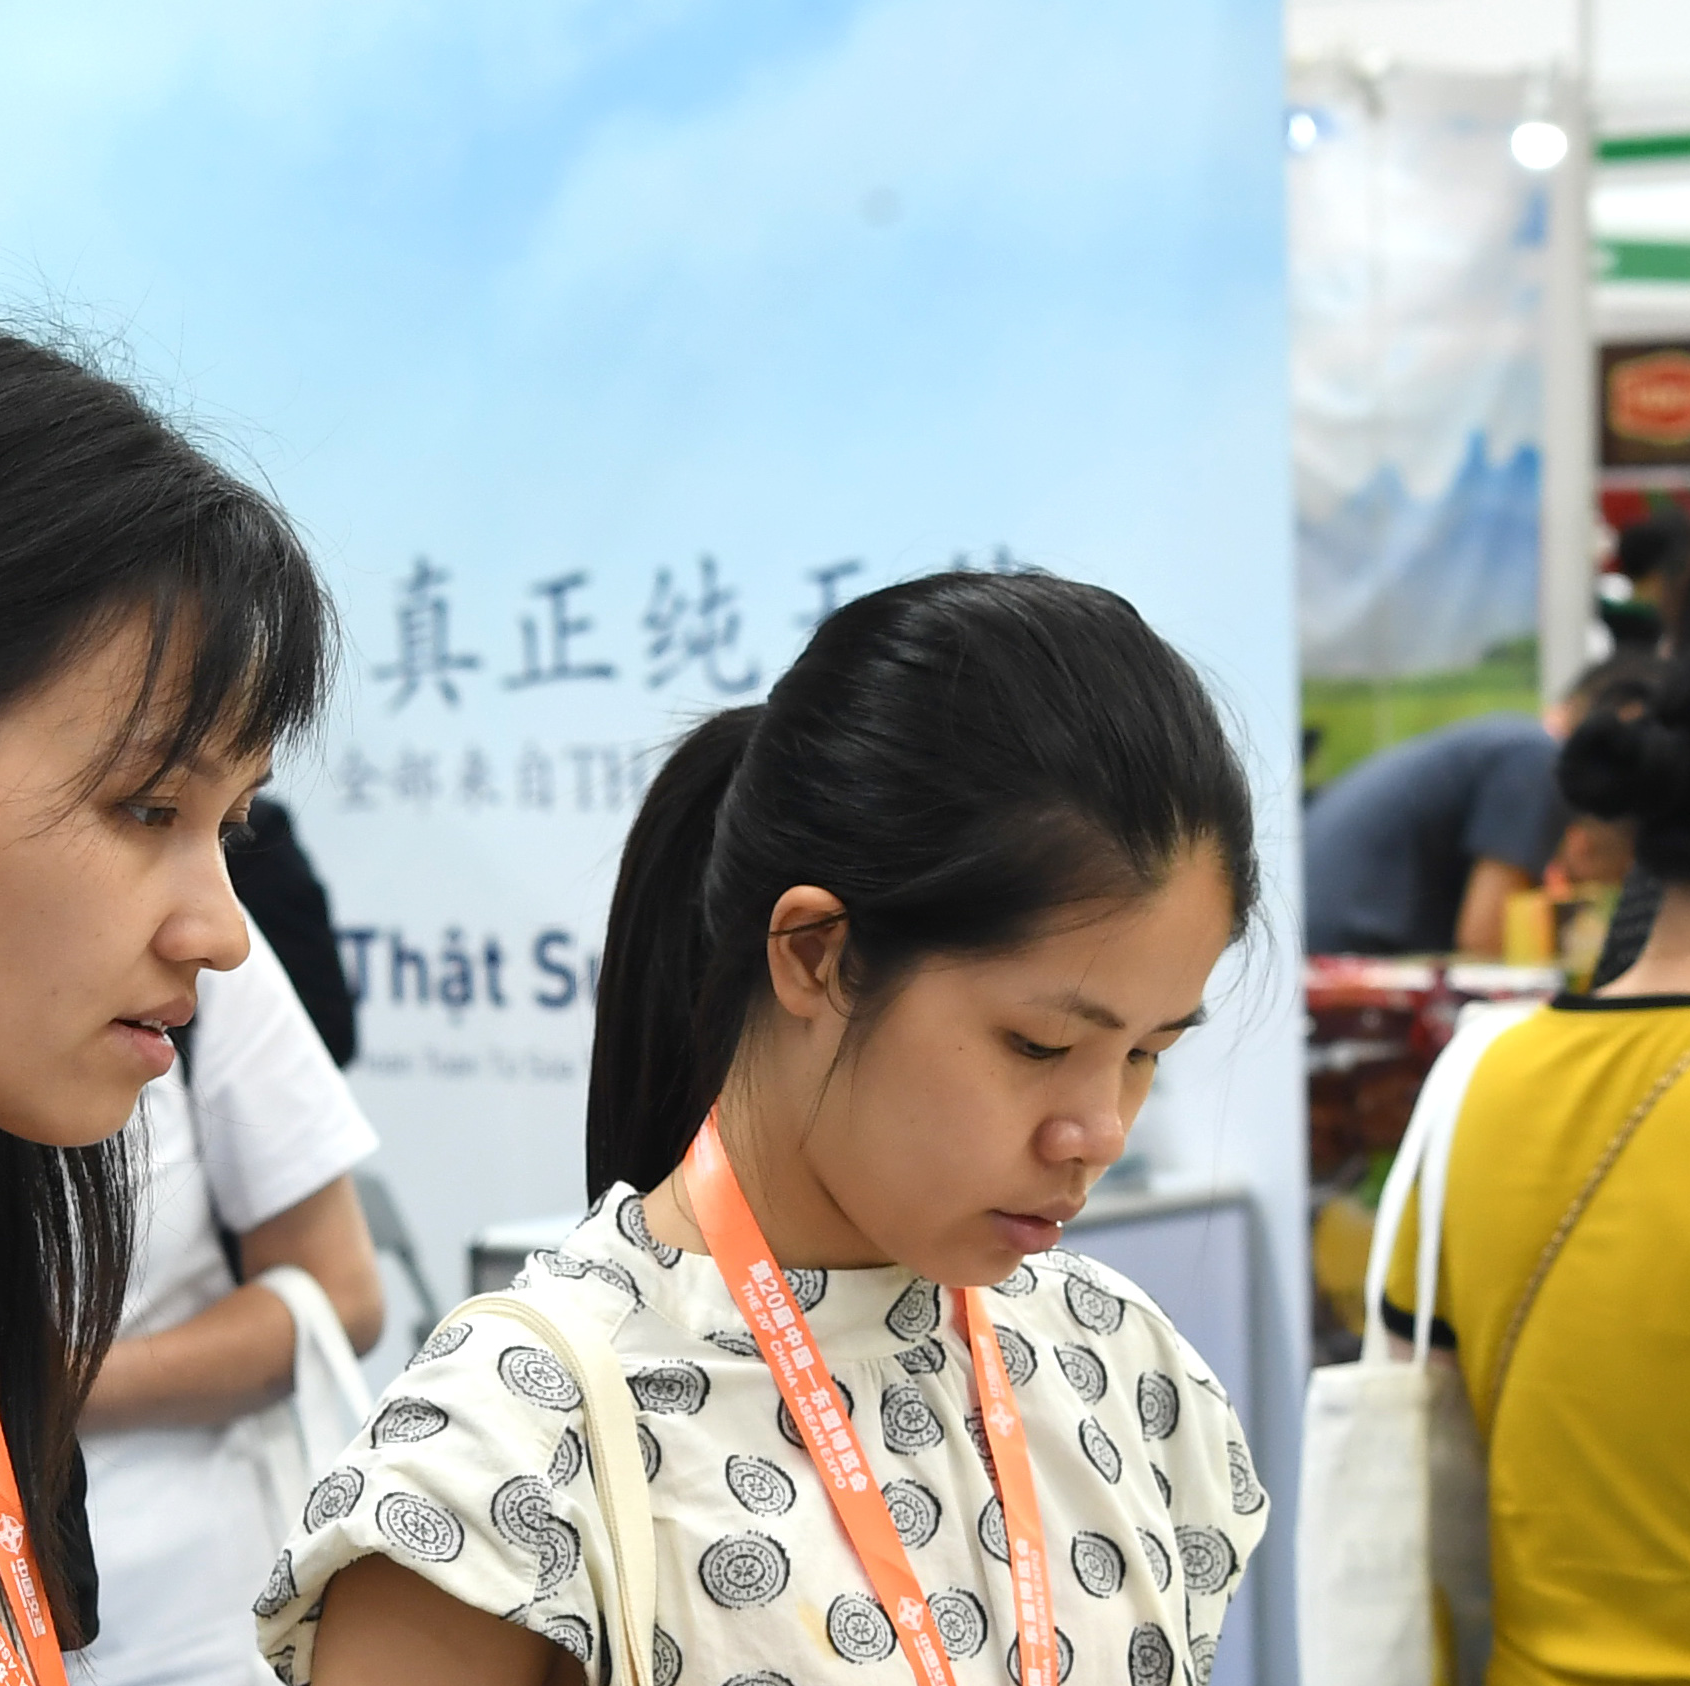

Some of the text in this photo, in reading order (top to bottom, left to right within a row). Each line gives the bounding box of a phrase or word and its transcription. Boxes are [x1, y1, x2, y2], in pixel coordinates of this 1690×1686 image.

[741, 1280, 767, 1315] THE
[768, 1338, 826, 1452] CHINA-ASEAN
[818, 1447, 848, 1491] EXPO
[1028, 1549, 1042, 1590] EXPO
